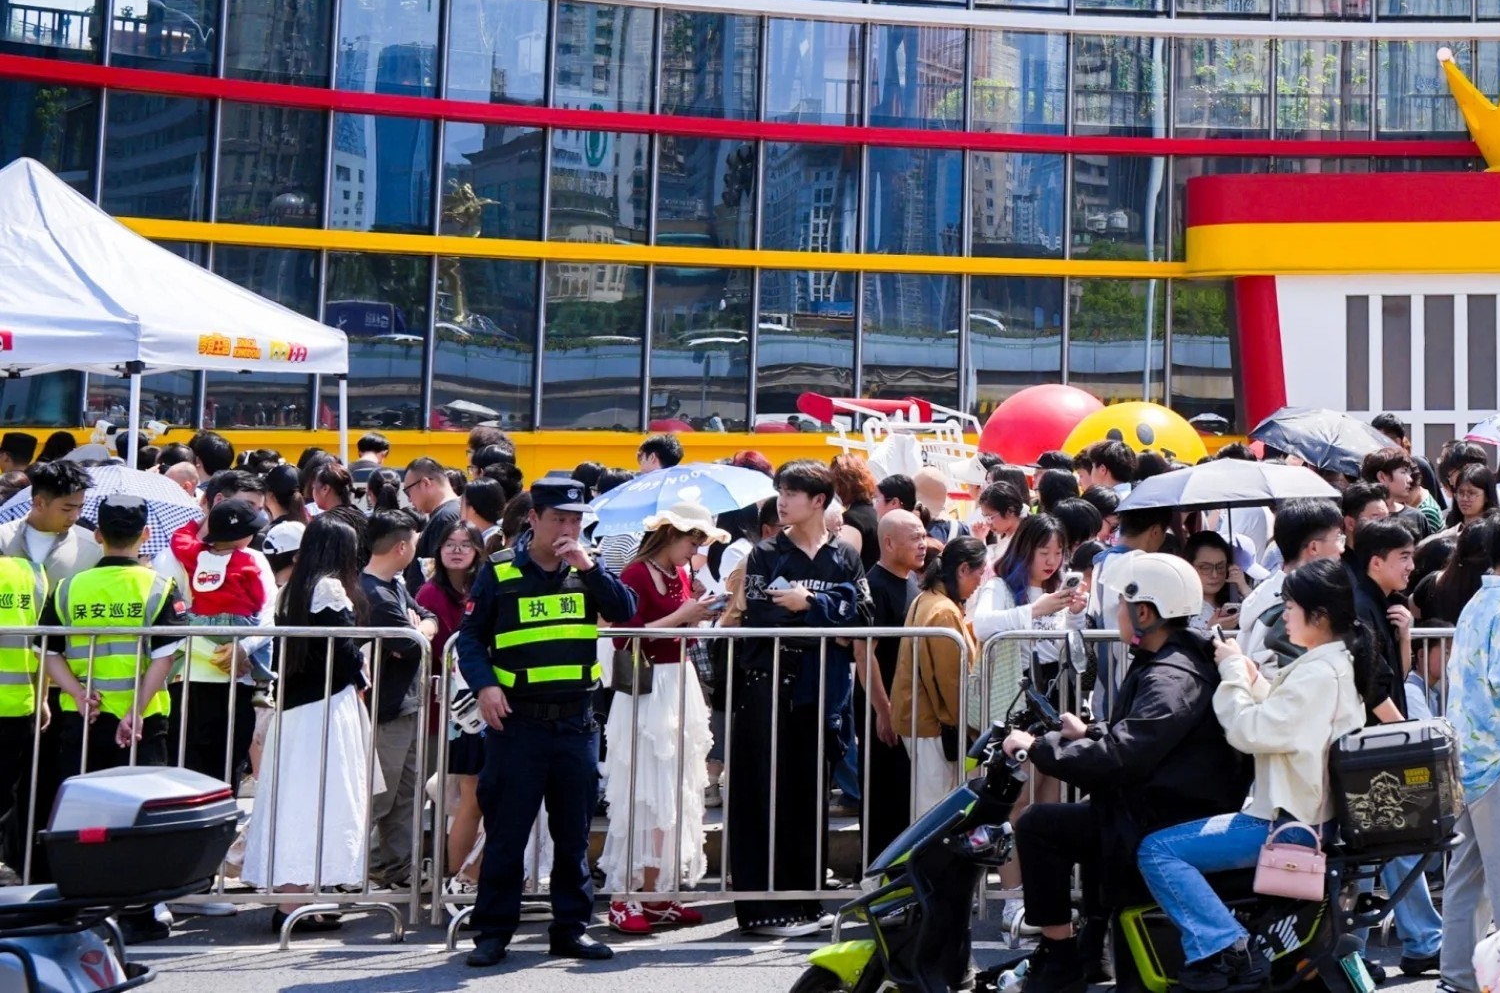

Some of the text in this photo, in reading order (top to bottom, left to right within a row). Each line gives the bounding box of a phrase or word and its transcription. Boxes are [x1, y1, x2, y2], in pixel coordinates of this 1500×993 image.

[0, 594, 30, 609] 巡逻
[528, 597, 577, 617] 执勤
[73, 602, 143, 619] 保安巡逻
